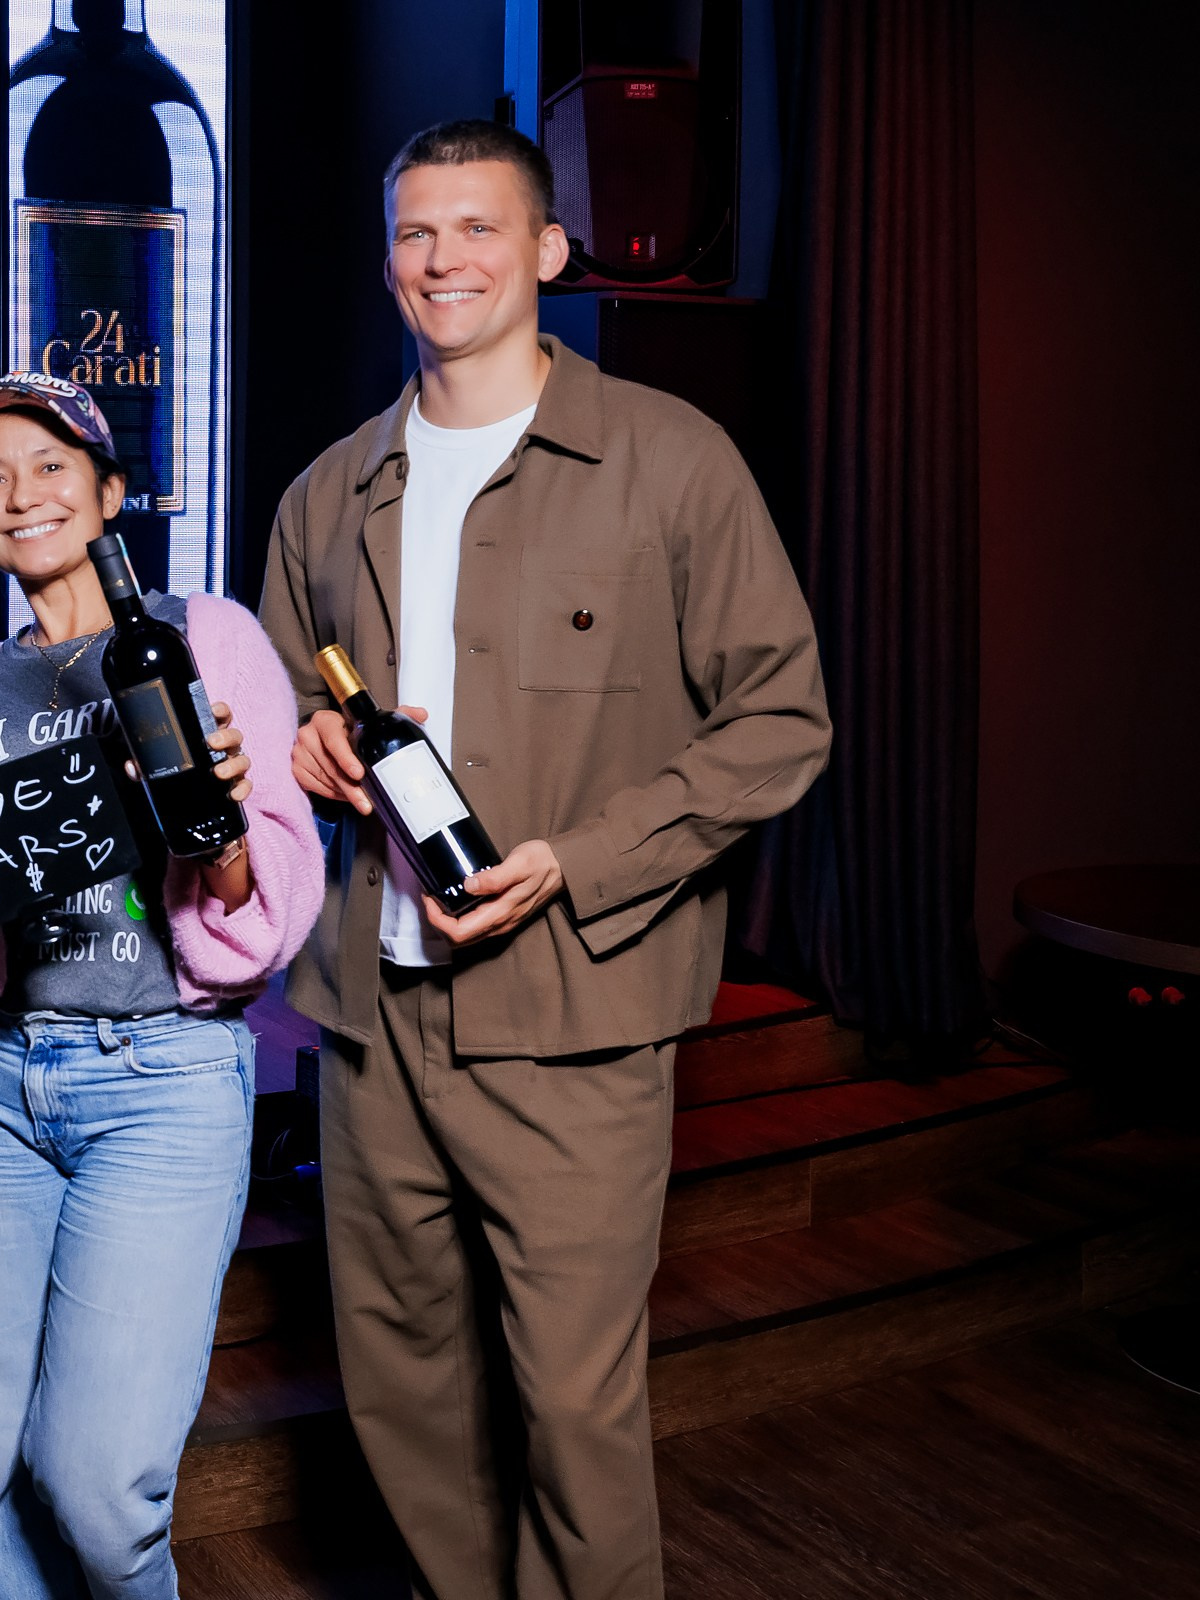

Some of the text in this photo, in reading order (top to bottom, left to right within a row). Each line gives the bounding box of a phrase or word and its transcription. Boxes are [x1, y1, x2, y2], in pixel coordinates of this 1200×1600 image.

[80, 309, 124, 353] 24
[41, 339, 161, 386] Carati
[112, 931, 141, 963] GO
